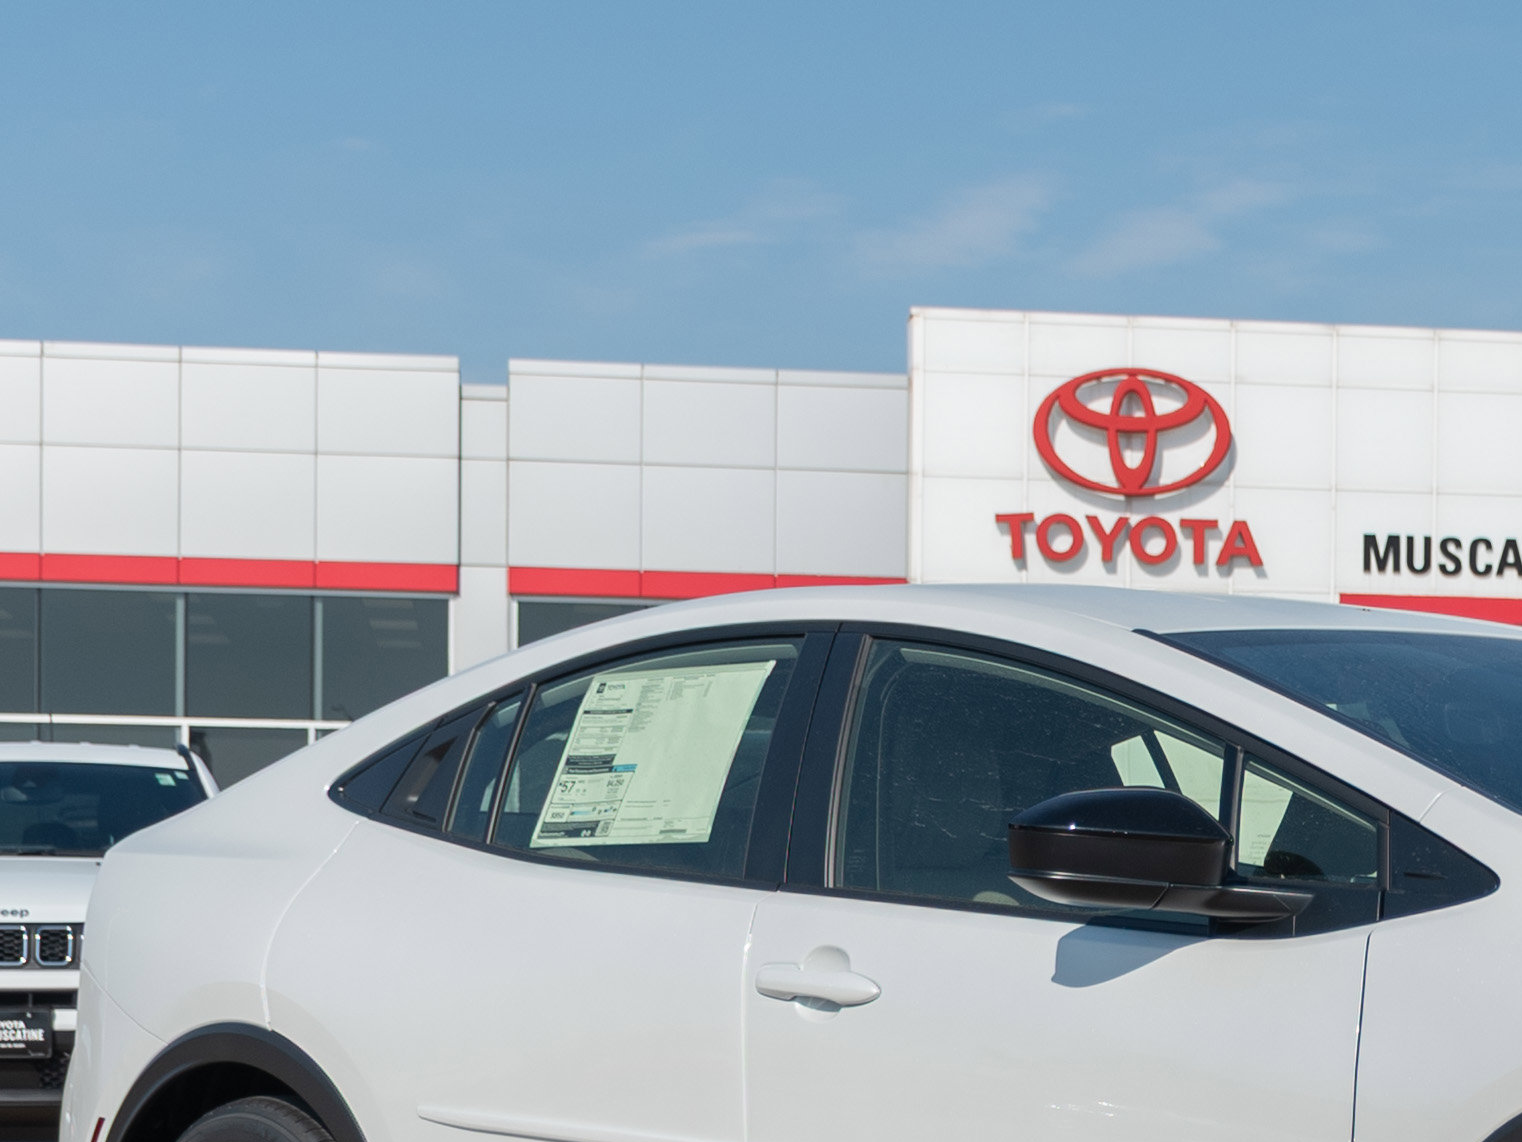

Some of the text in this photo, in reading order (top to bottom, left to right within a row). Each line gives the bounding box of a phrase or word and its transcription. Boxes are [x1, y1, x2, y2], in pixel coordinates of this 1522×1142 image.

[994, 512, 1263, 566] TOYOTA
[0, 908, 30, 919] eep
[0, 1020, 26, 1029] YOTA
[0, 1029, 45, 1041] SCATINE
